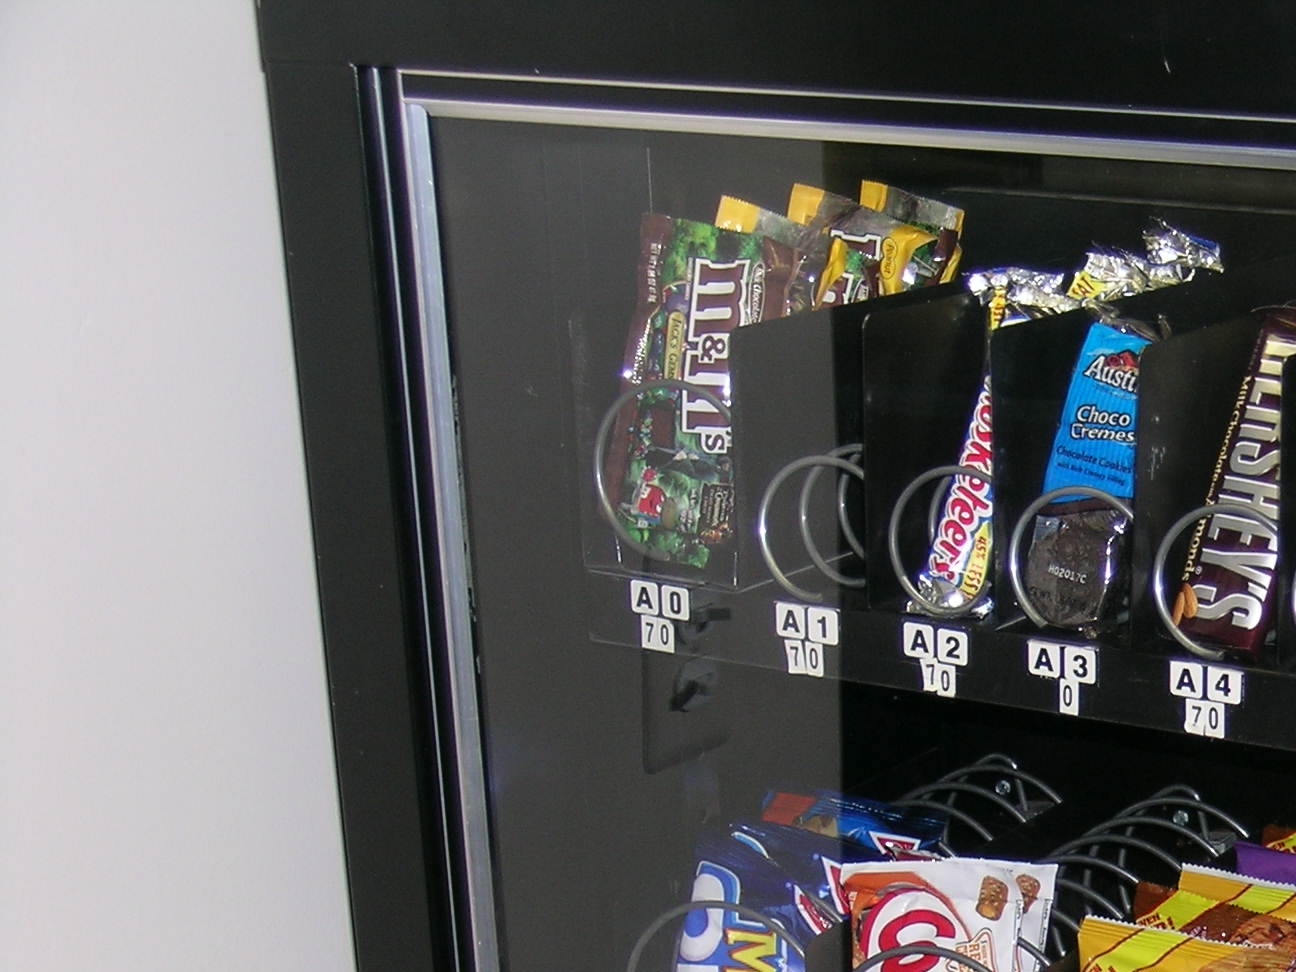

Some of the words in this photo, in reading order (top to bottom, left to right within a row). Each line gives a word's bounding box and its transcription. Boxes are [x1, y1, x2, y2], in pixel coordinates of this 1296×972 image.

[1084, 355, 1138, 394] Austi
[1076, 405, 1131, 427] Choco
[1071, 423, 1136, 443] Cremes
[1182, 498, 1216, 582] Amonds
[645, 622, 669, 646] 70
[789, 646, 819, 669] 70
[925, 663, 950, 692] 70
[1191, 706, 1219, 730] 70
